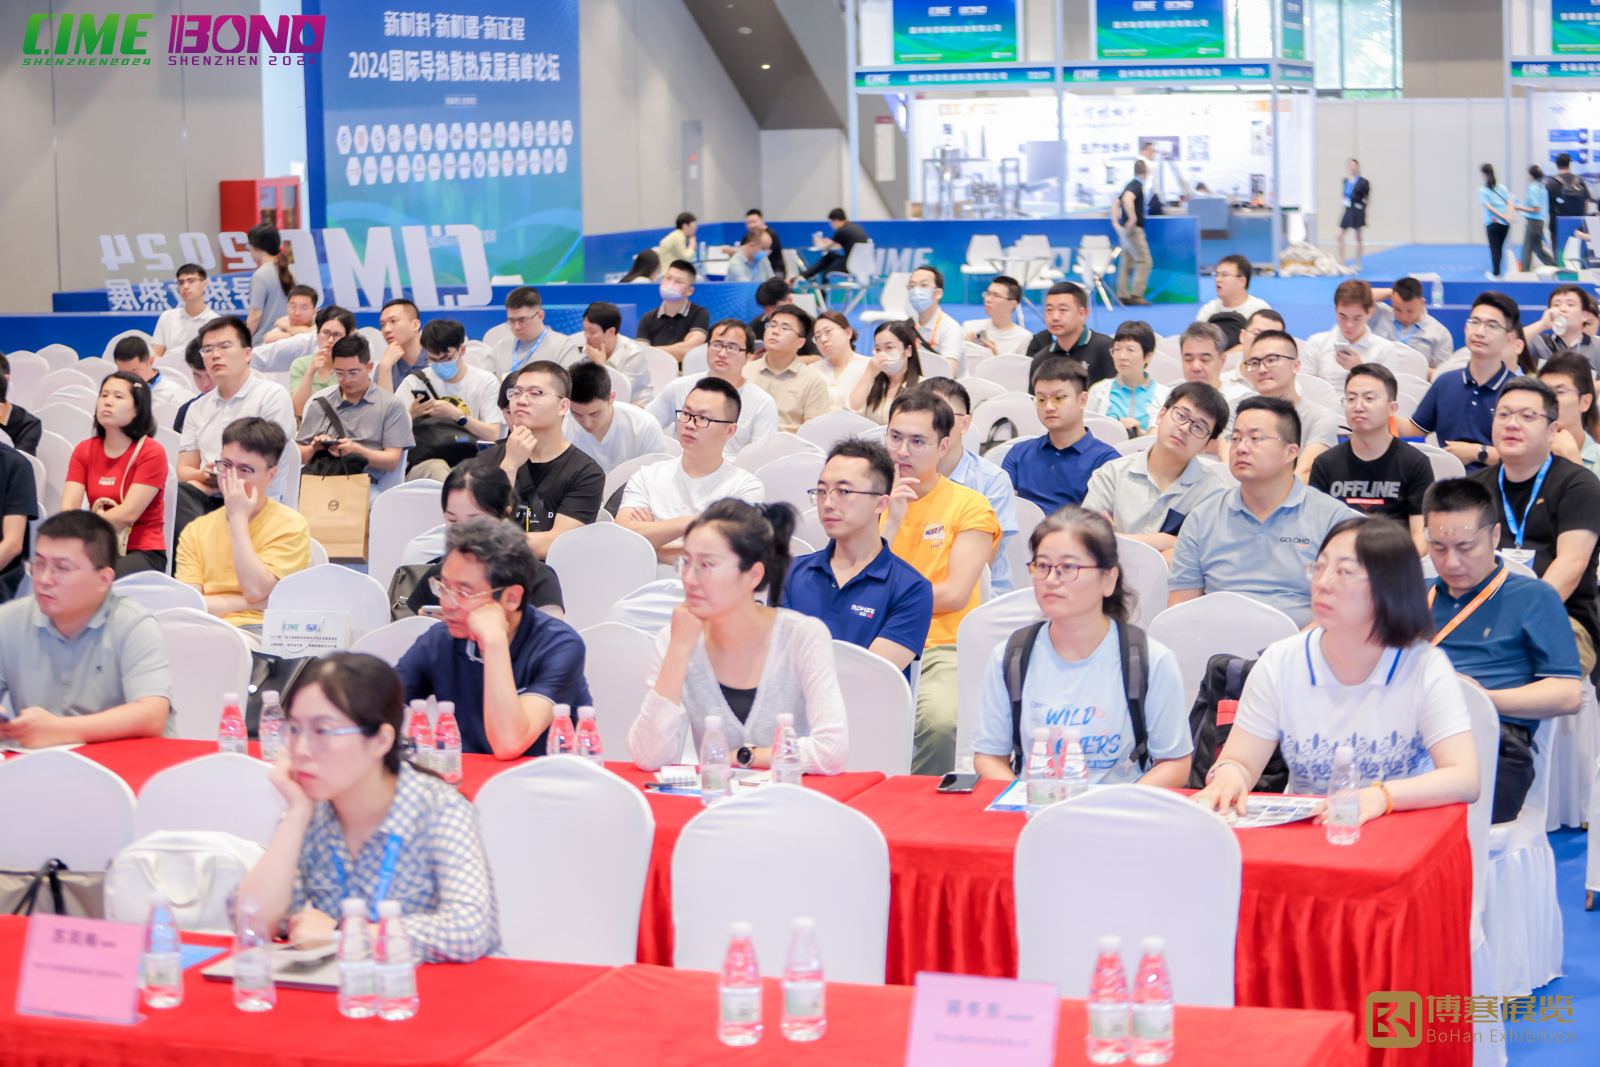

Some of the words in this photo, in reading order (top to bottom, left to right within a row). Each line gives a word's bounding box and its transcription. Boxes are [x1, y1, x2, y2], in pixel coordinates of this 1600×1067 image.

[349, 50, 561, 82] 2024国际导热散热发展高峰论坛
[1330, 480, 1401, 498] OFFLINE
[1046, 706, 1096, 726] WILD
